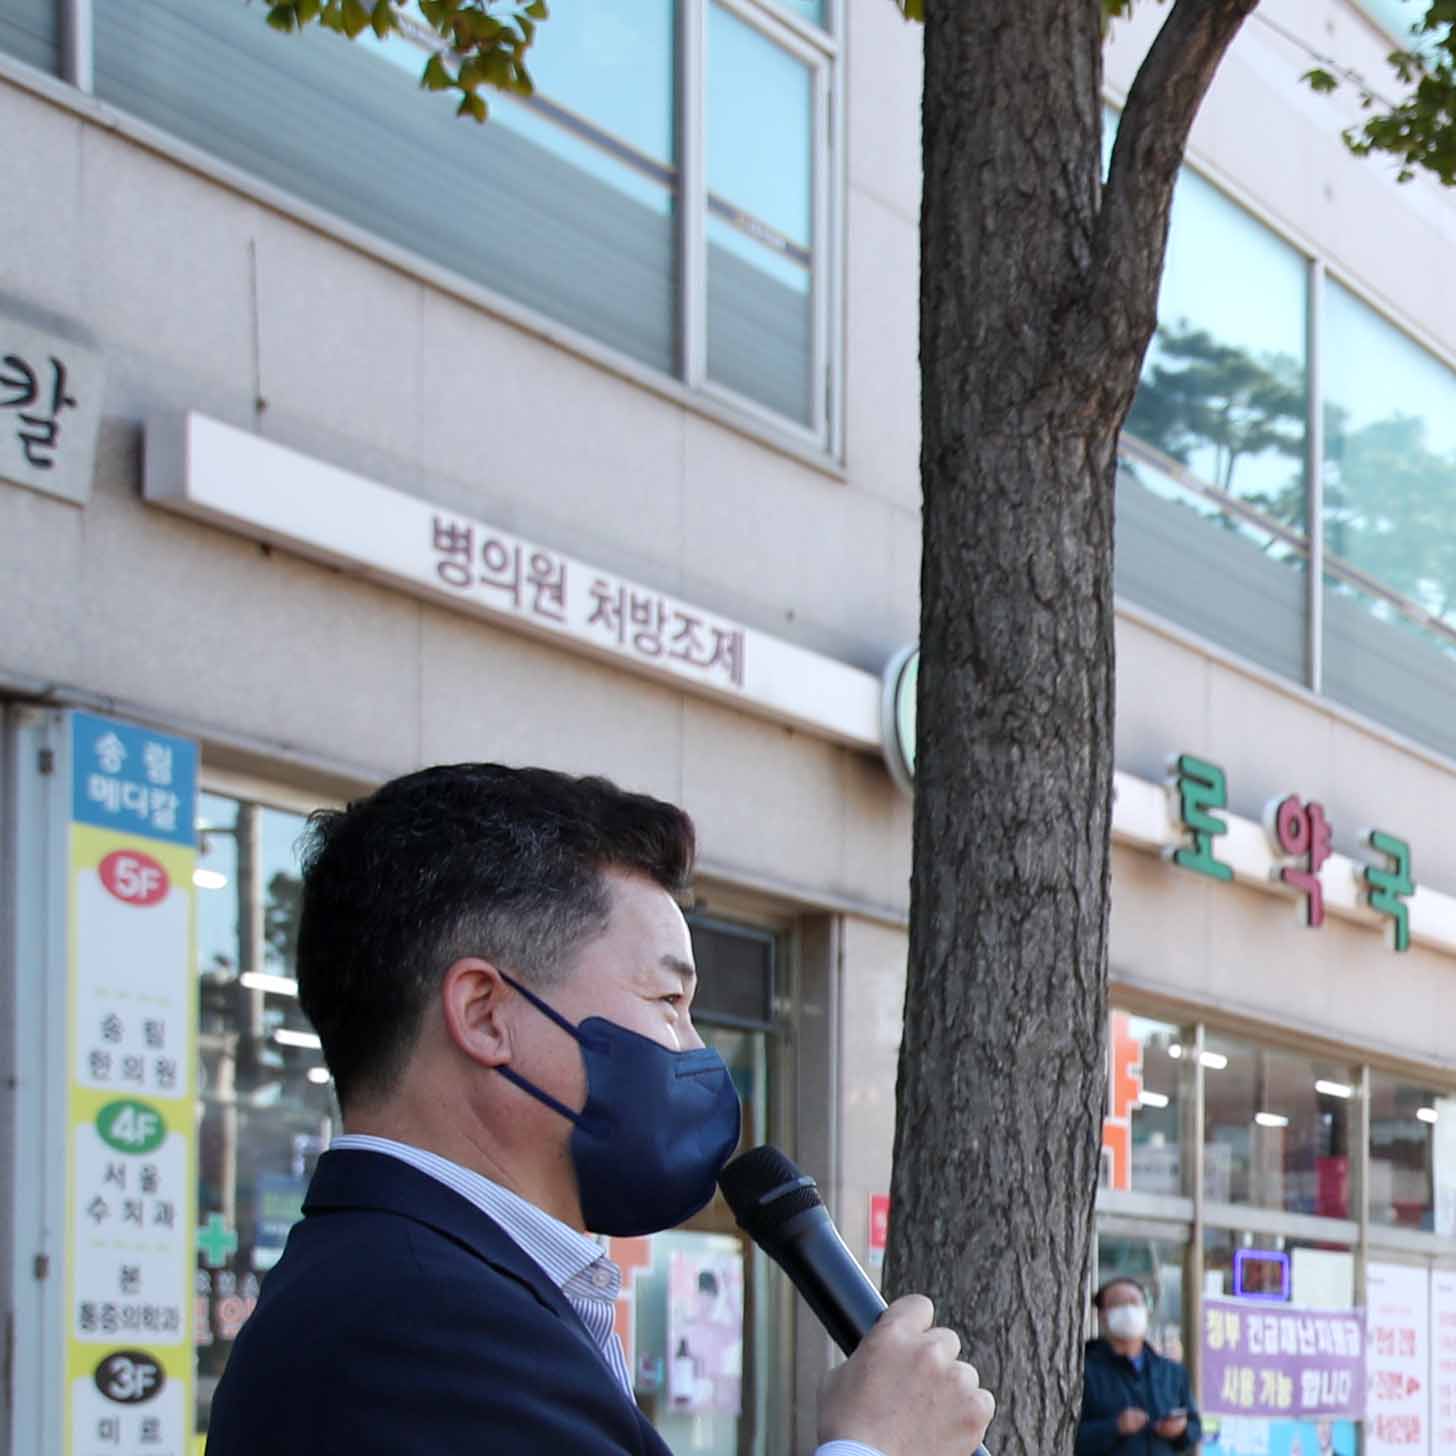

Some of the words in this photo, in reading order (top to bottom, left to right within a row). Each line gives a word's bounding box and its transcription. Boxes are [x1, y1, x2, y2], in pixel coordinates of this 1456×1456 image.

[430, 516, 567, 622] 병의원
[587, 577, 745, 688] 처방조제
[113, 857, 162, 900] 5F
[111, 1107, 159, 1145] 4F
[108, 1355, 159, 1401] 3F
